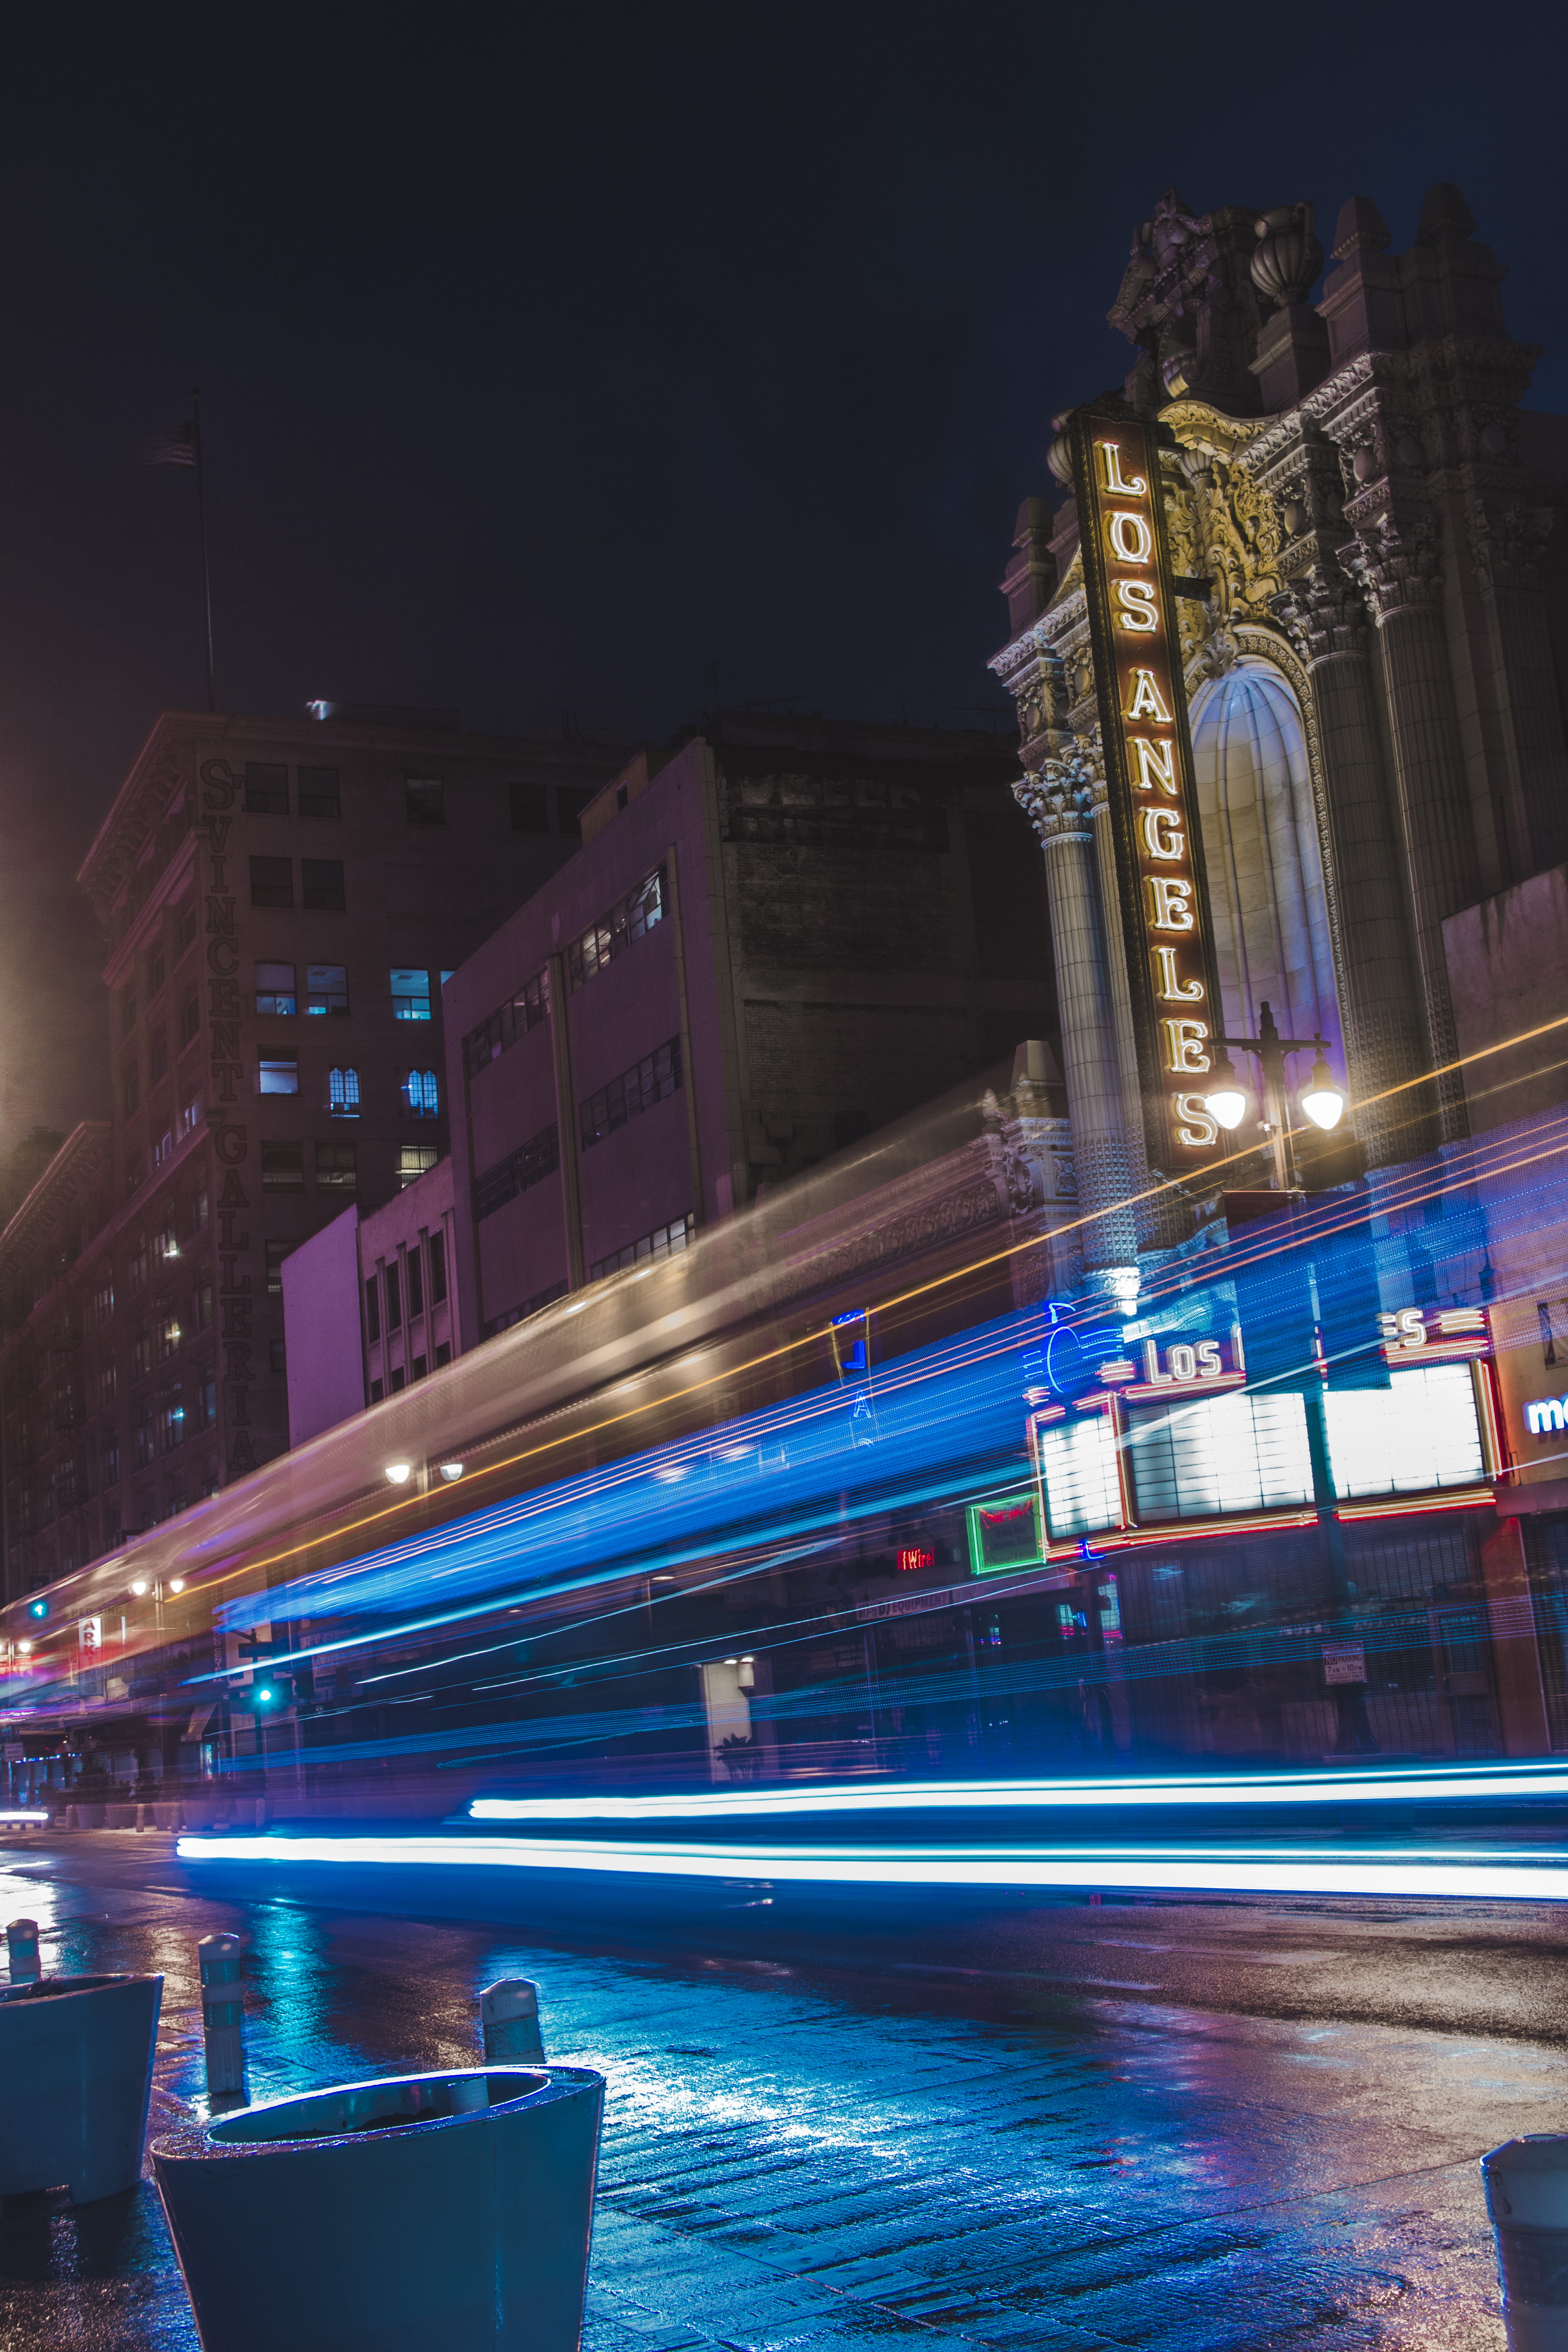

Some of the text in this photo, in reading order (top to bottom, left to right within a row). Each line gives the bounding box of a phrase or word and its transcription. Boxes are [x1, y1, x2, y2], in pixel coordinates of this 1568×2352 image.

[1095, 441, 1219, 1147] LOS ANGELES
[202, 815, 243, 1102] VINCENT
[215, 1124, 260, 1471] GALLERIA
[878, 1600, 891, 1617] DJ
[892, 1592, 948, 1613] EQUIPMENT
[1326, 1654, 1362, 1665] NO PARKING
